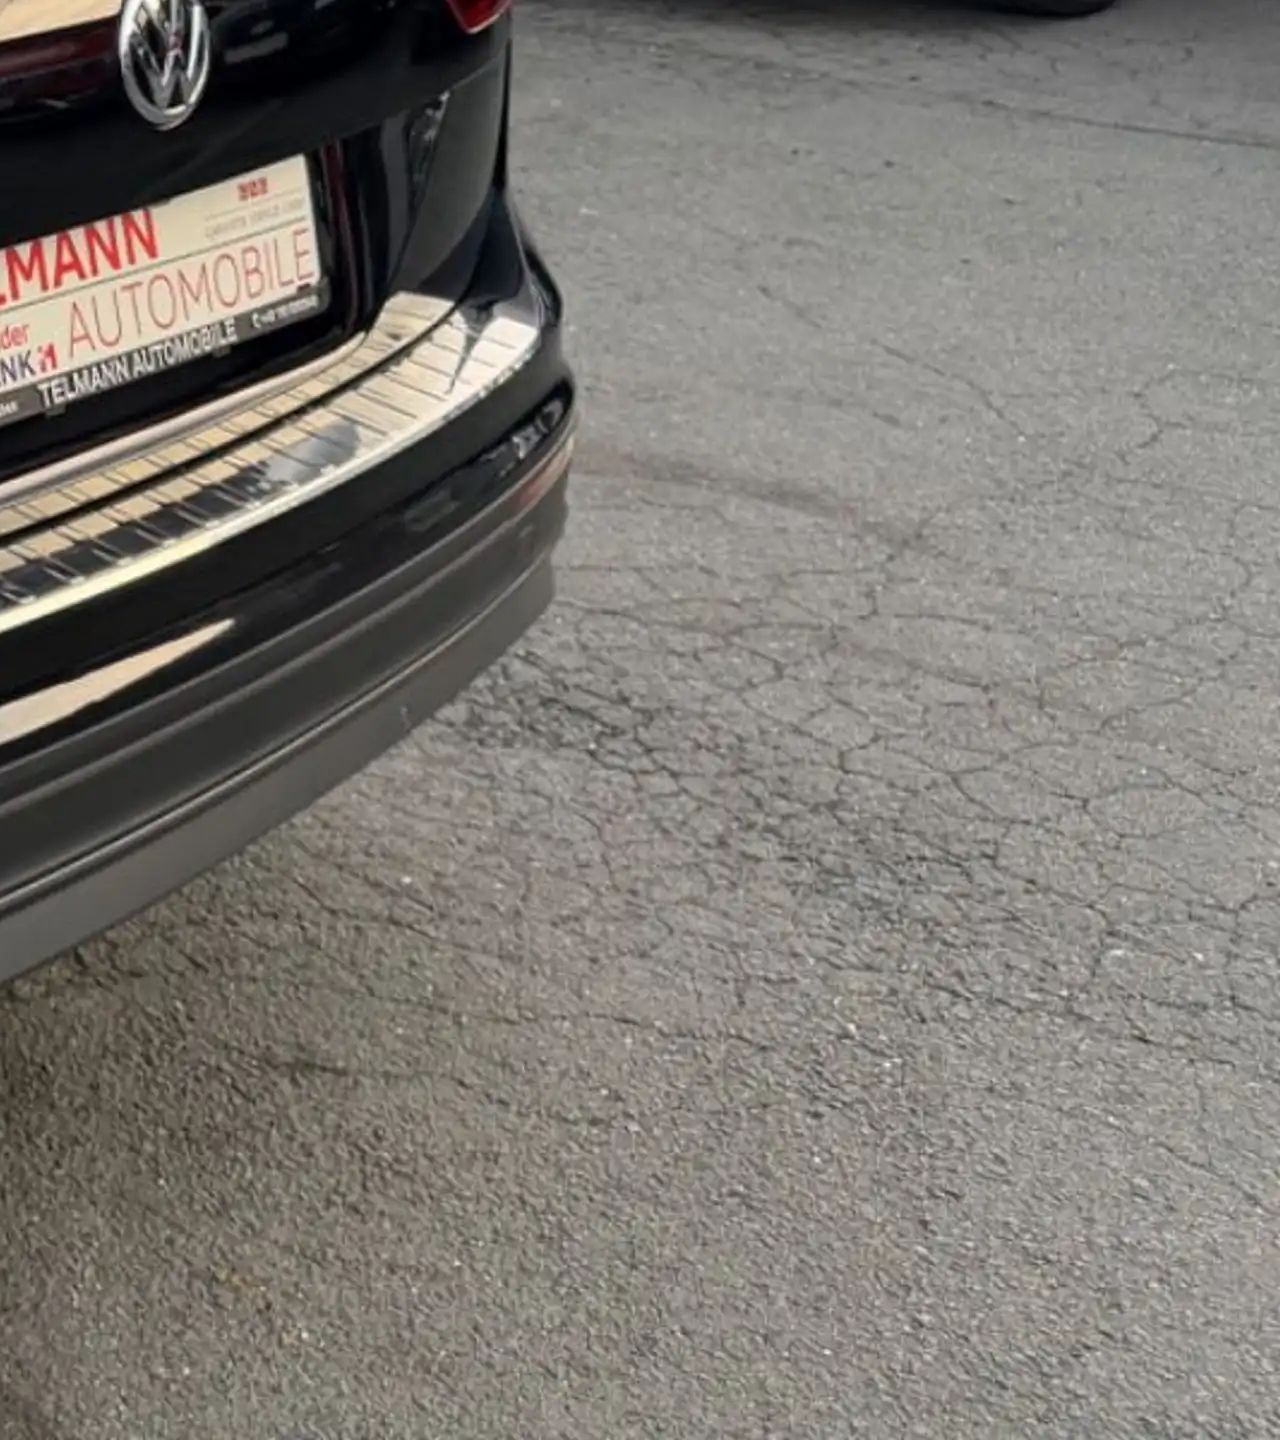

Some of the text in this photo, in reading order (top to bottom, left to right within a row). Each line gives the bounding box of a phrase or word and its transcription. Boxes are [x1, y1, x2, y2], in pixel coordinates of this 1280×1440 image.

[69, 227, 314, 358] AUTOMOBILE
[36, 316, 238, 408] TELMANN AUTOMOBILE
